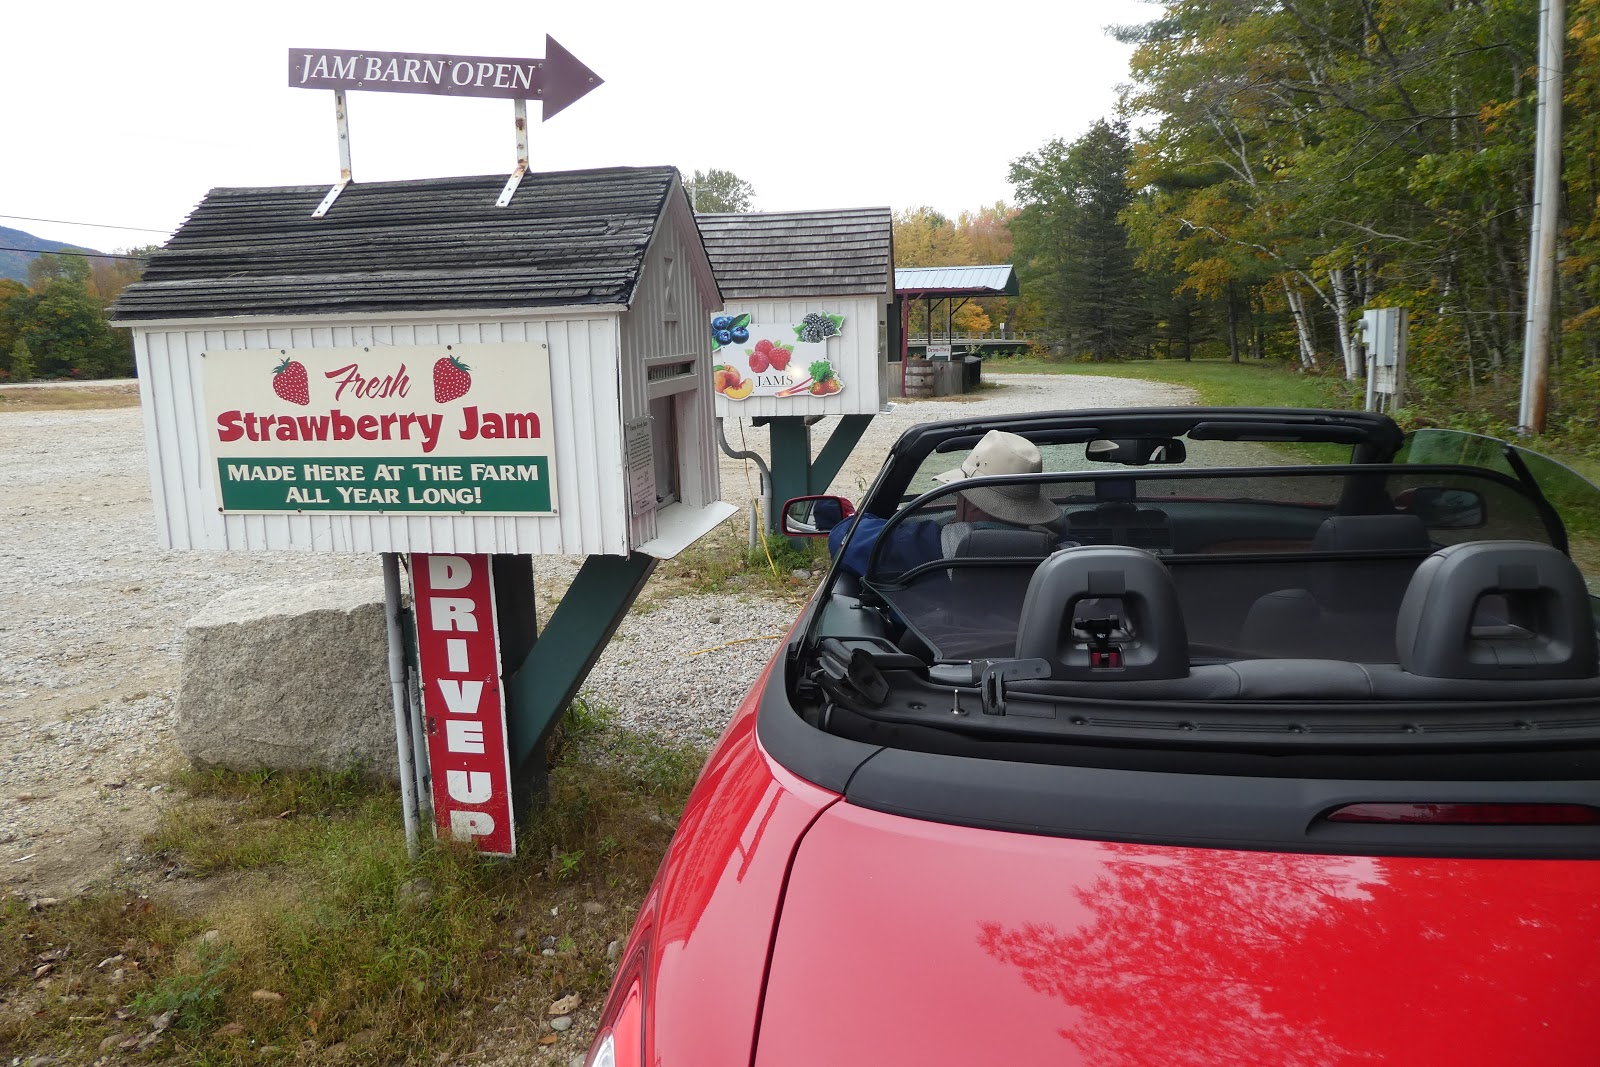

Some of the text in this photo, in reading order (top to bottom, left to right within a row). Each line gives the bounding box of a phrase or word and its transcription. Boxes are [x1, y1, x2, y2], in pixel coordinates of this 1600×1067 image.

[300, 54, 536, 90] JAM BARN OPEN
[325, 363, 412, 402] Fresh
[755, 375, 794, 388] JAMS
[216, 405, 541, 453] Strawberry Jam
[227, 463, 539, 482] MADE HERE AT THE FARM
[285, 486, 483, 505] ALL YEAR LONG!
